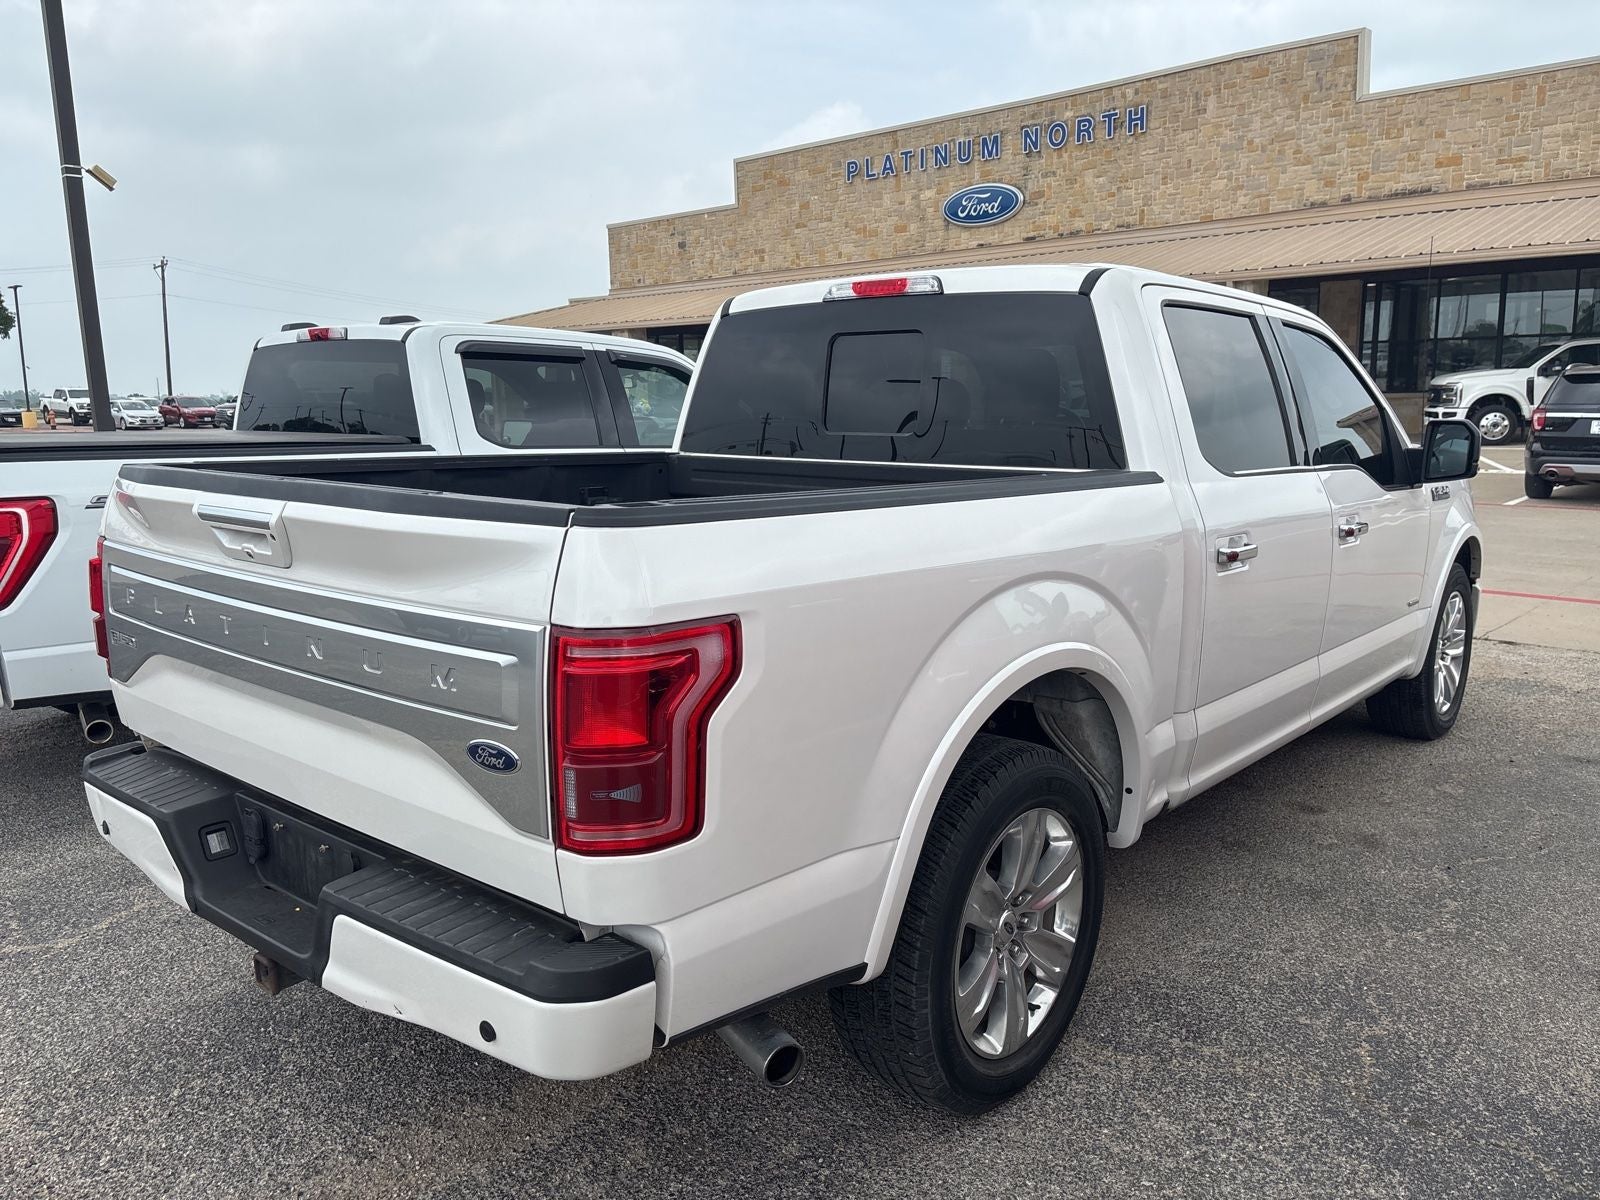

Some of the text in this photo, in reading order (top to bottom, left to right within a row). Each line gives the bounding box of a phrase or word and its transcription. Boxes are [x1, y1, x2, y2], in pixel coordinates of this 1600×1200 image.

[845, 104, 1148, 183] PLATINUM NORTH
[957, 192, 1002, 218] Ford
[125, 587, 458, 692] PLATINUM
[475, 745, 506, 769] Ford
